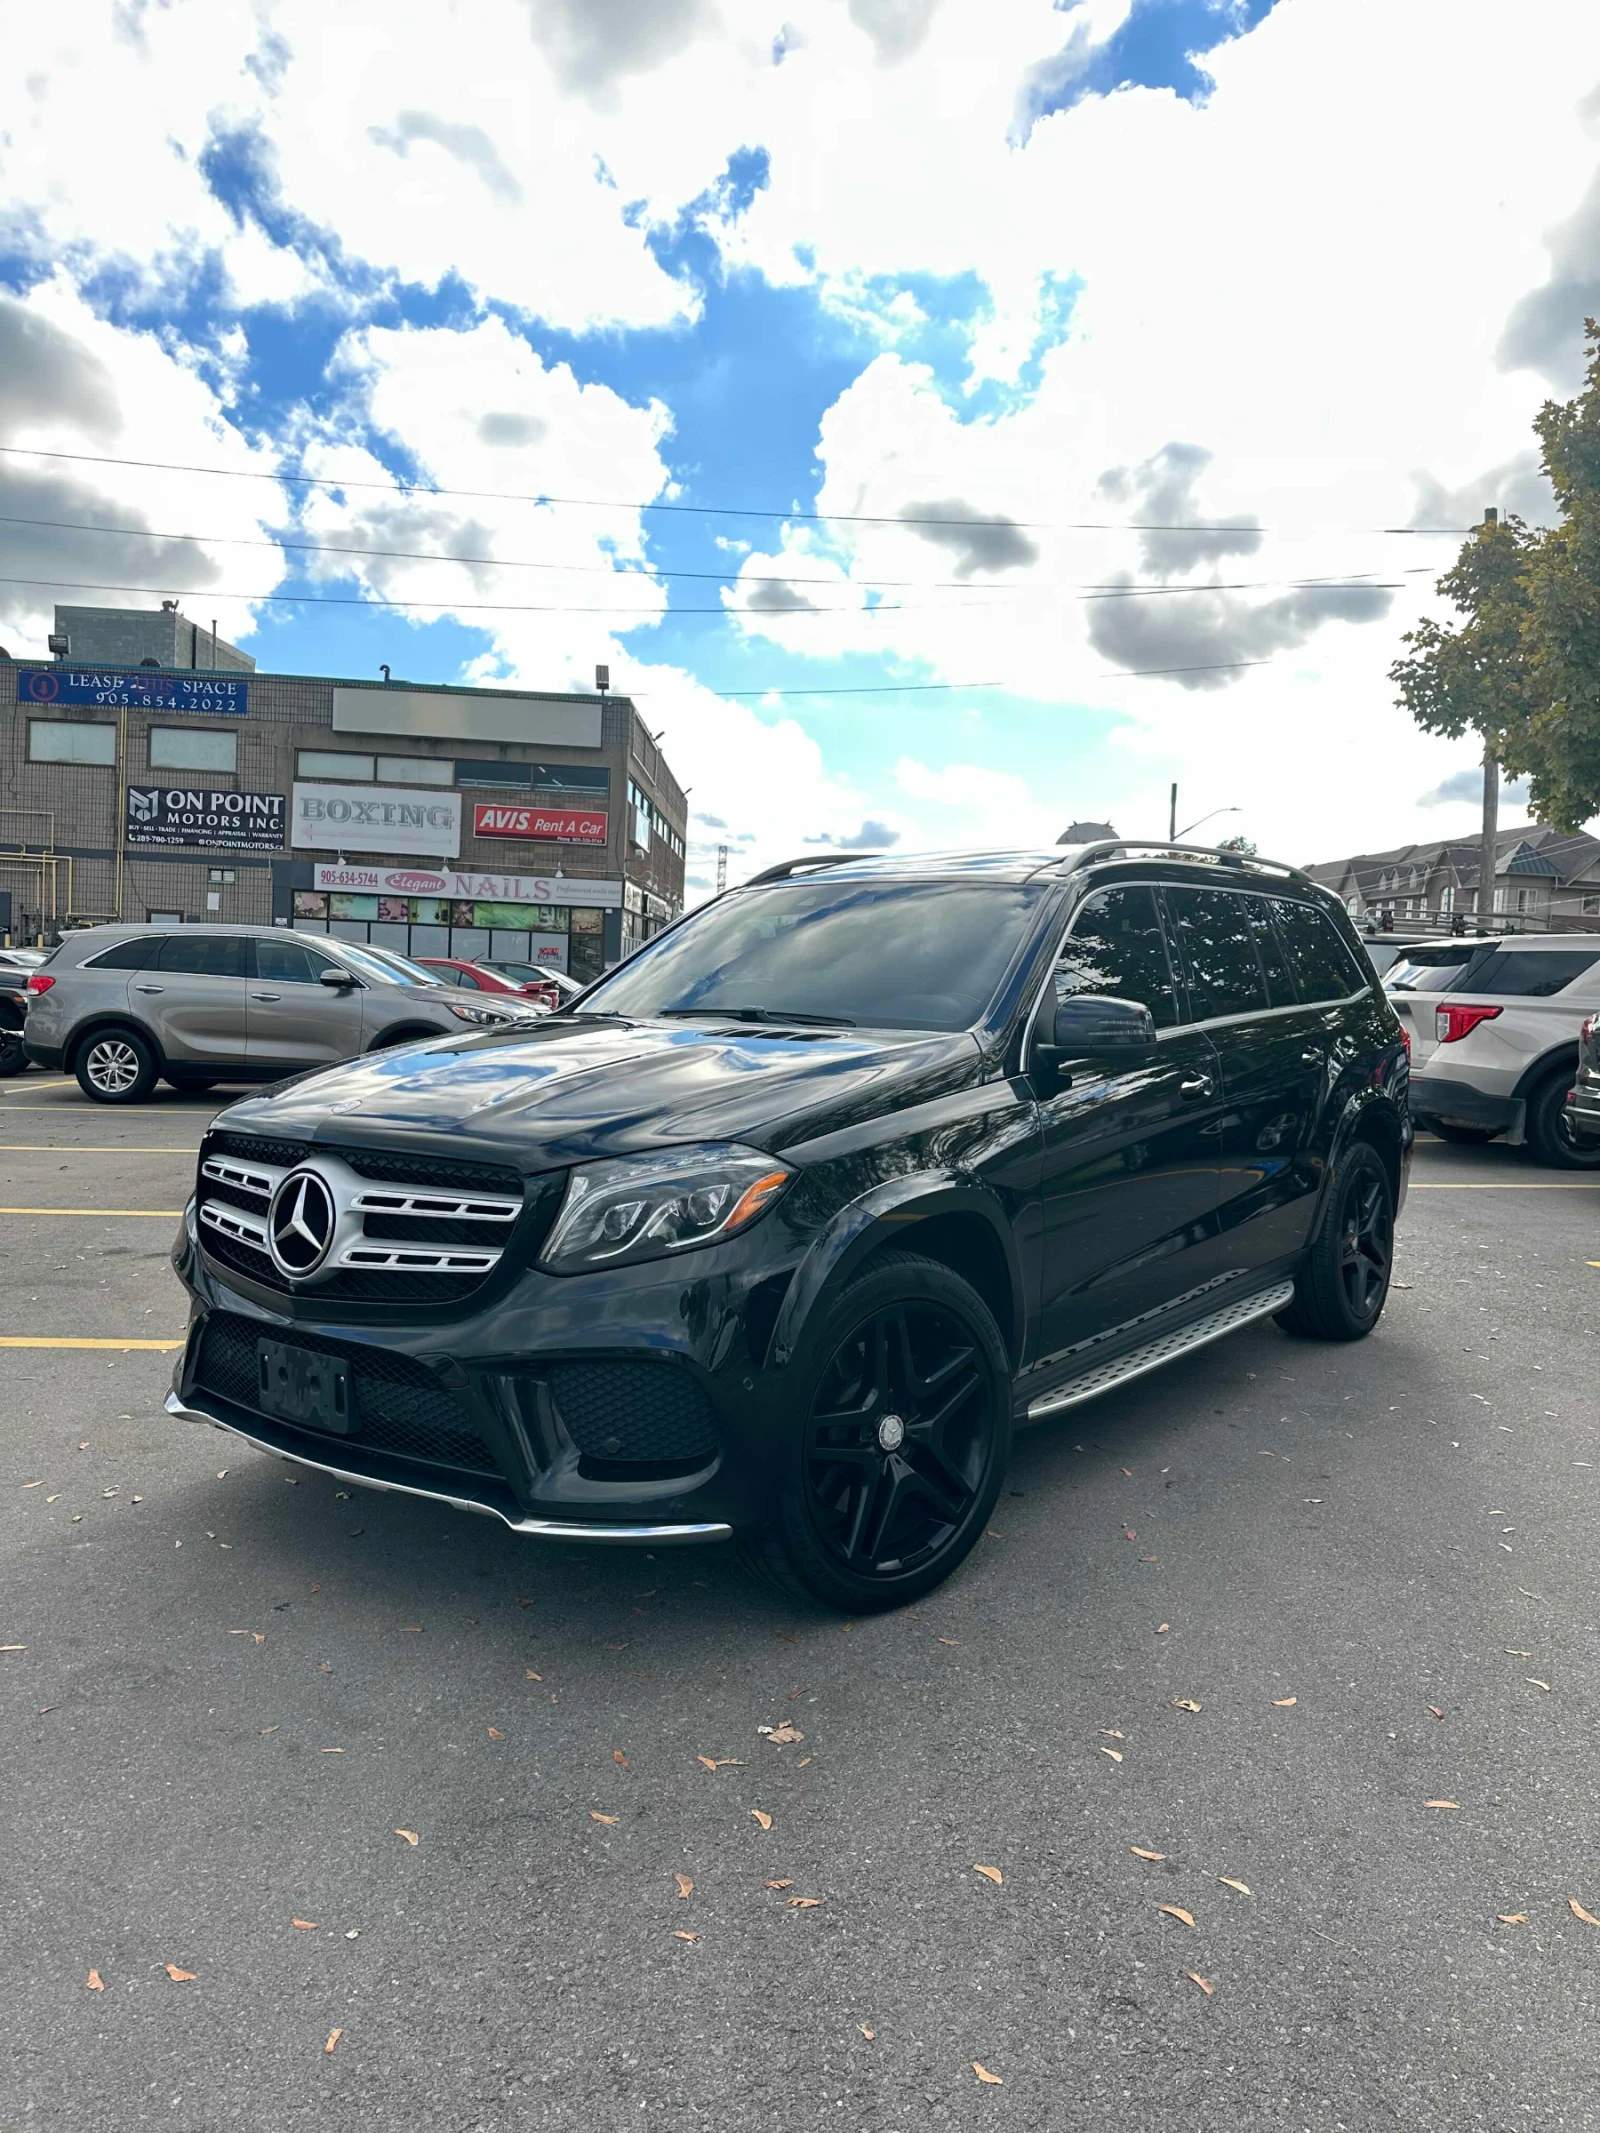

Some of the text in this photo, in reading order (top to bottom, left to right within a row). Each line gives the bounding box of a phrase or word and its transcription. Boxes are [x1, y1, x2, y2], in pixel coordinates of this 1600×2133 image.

[69, 673, 123, 688] LEASE
[183, 681, 237, 695] SPACE
[166, 790, 284, 815] ON POINT
[300, 797, 456, 830] BOXING
[167, 812, 284, 830] MOTORS INC.
[480, 809, 603, 835] AVIS Rent A Car
[321, 870, 551, 900] 905-634-5744 Elegant NAILS
